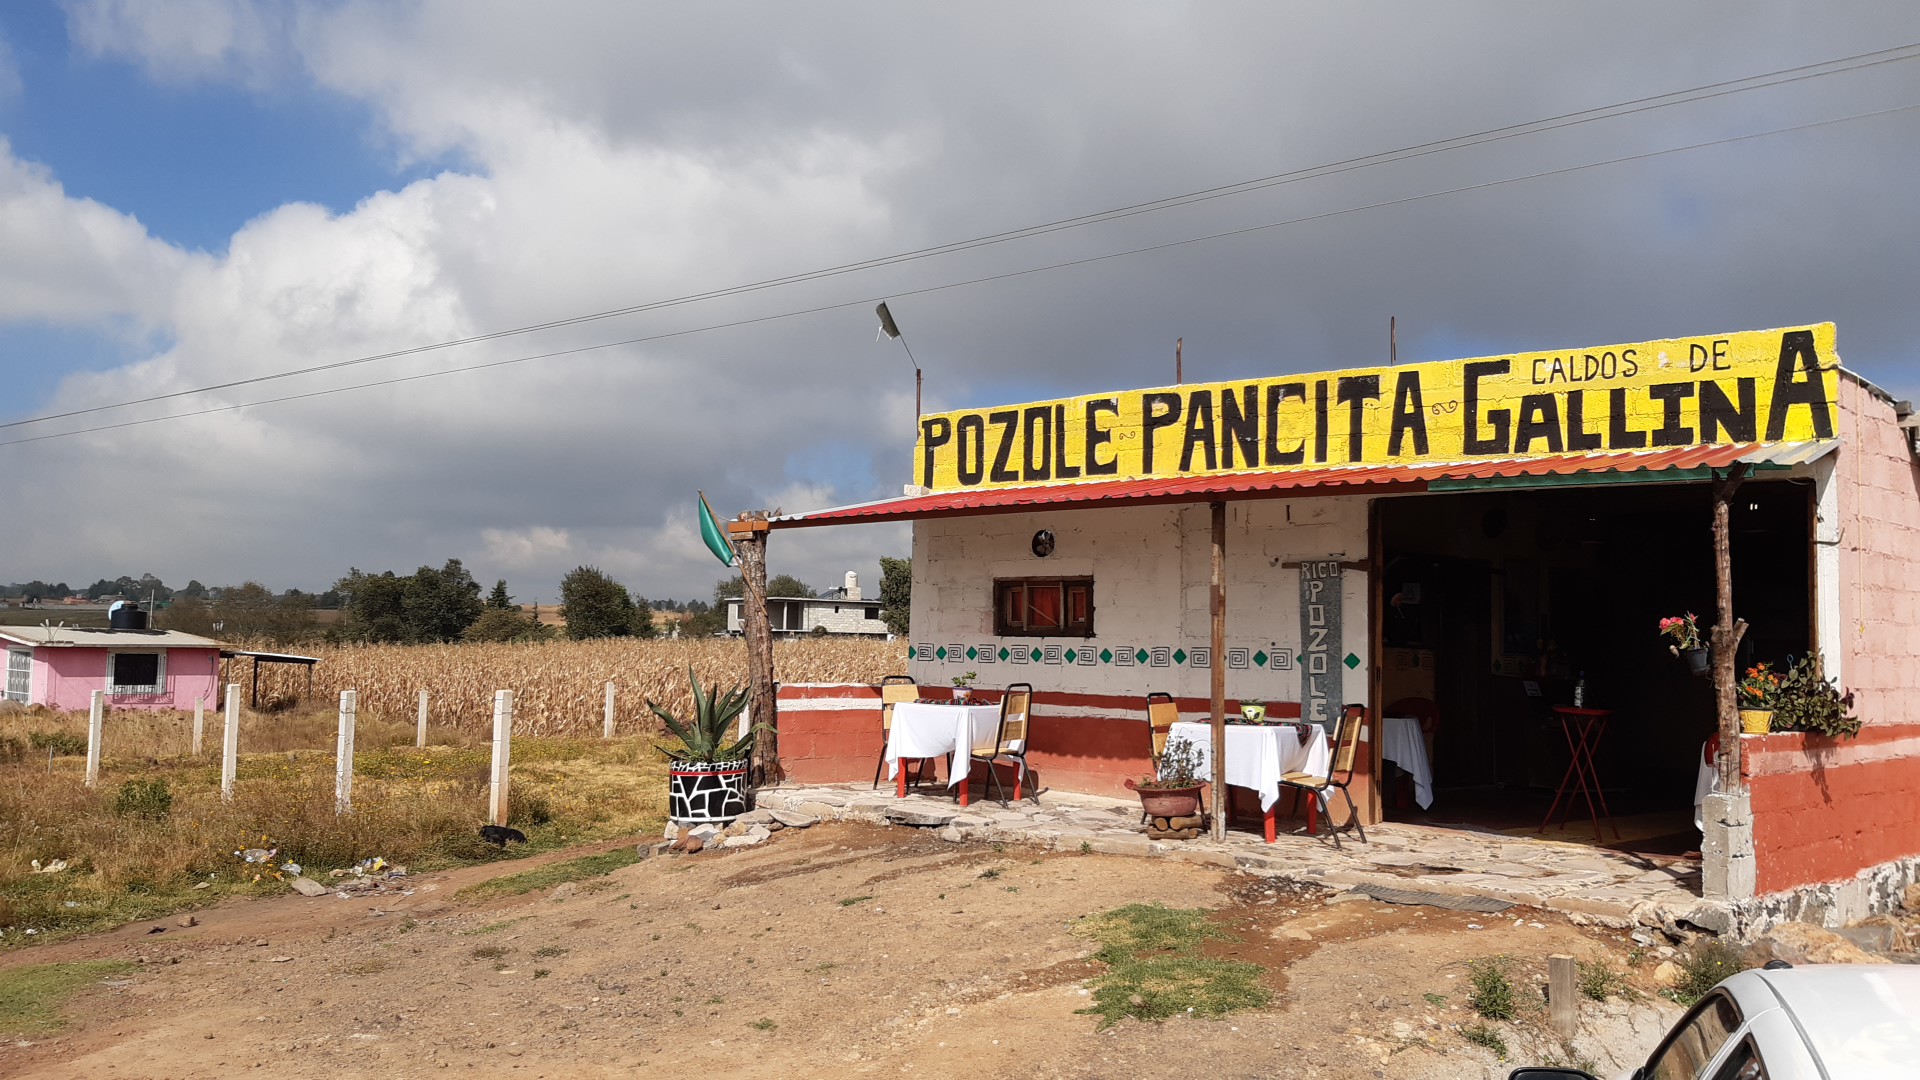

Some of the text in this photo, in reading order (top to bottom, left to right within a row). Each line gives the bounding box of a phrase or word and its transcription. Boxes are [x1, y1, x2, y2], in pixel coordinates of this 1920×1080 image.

[921, 330, 1834, 489] POZOLE PANCITA GALLINA
[1532, 339, 1732, 386] CALDOS DE
[1301, 561, 1339, 579] RICO
[1308, 580, 1328, 722] POZOLE
